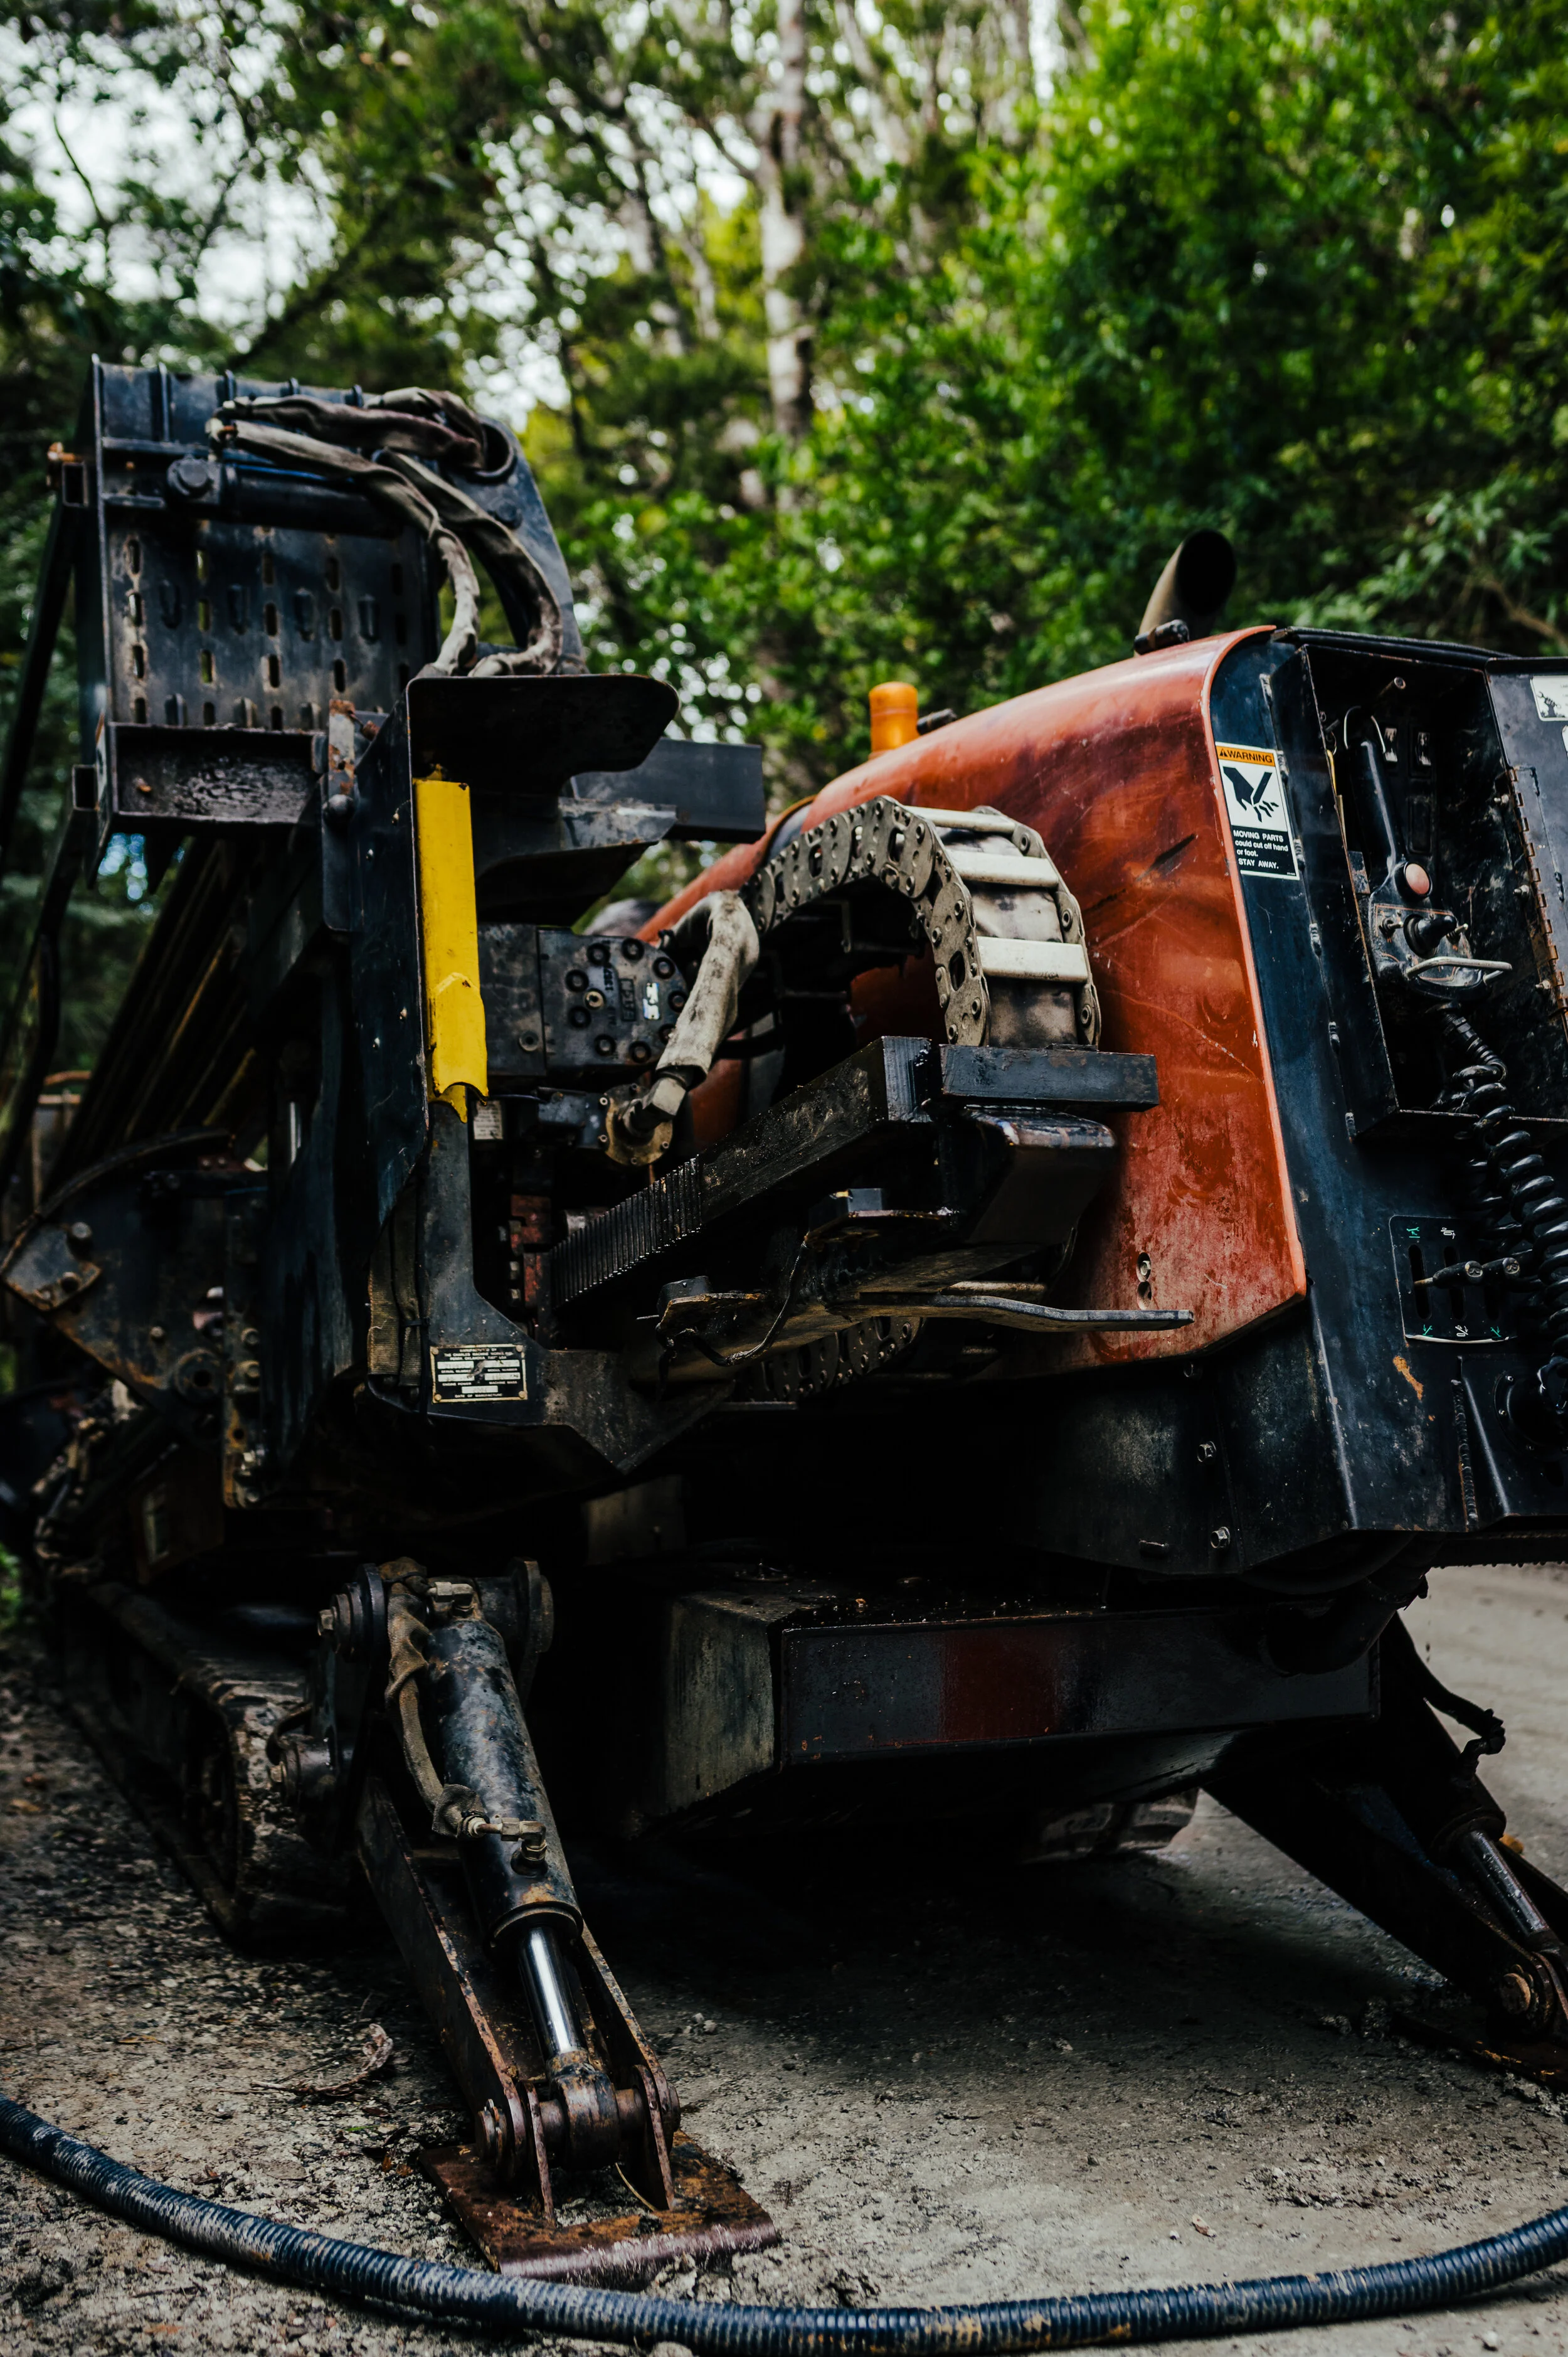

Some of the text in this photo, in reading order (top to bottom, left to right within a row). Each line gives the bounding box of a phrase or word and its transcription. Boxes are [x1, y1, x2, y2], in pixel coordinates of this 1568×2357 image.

[1227, 751, 1272, 763] WARNING
[1233, 830, 1283, 843] MOVING PARTS
[1273, 843, 1288, 851] hand
[1239, 858, 1279, 869] STAY AWAY.
